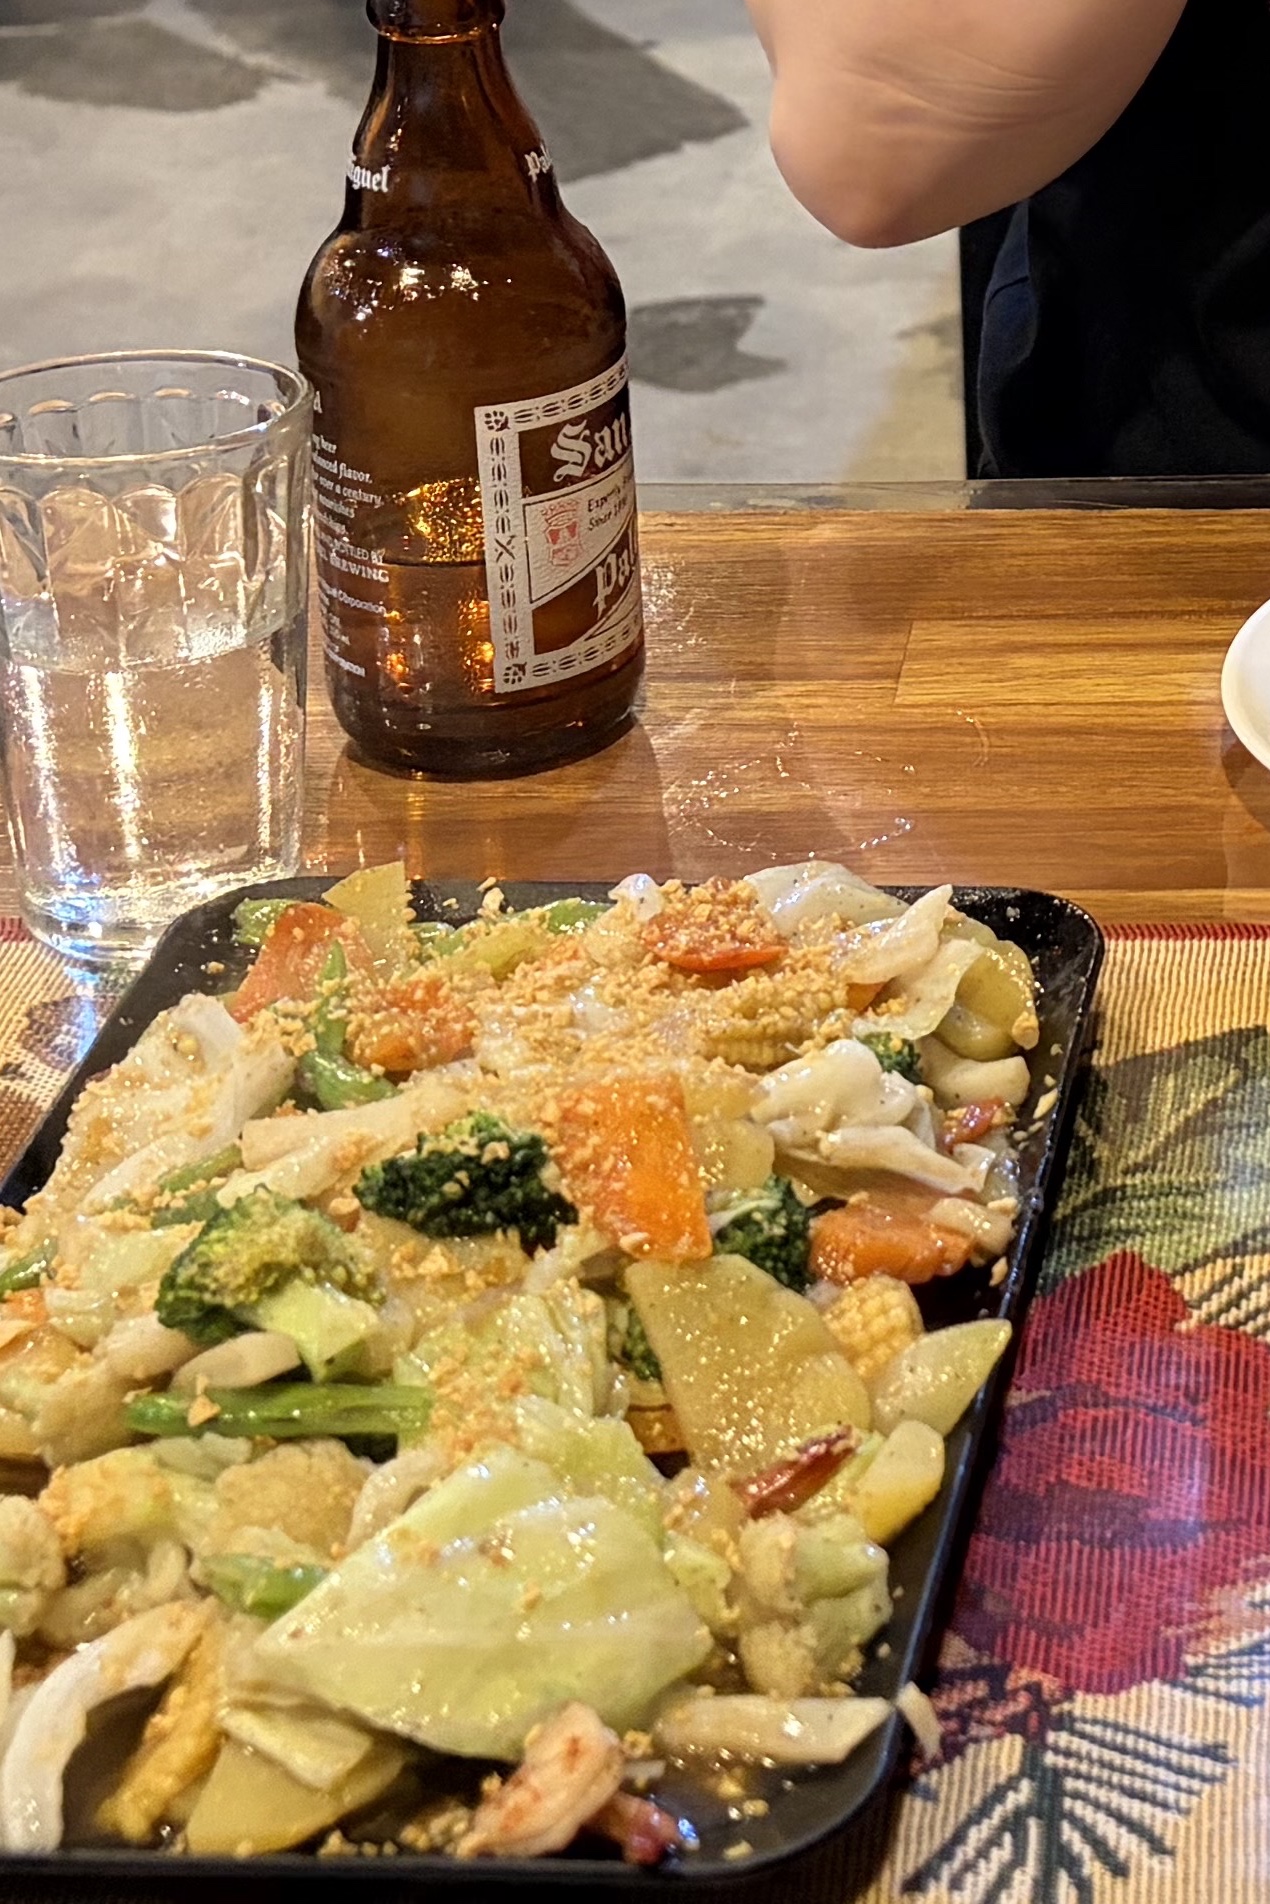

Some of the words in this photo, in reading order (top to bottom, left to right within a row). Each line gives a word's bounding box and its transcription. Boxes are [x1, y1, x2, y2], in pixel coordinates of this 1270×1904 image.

[339, 462, 373, 484] flavor.
[551, 412, 628, 482] San
[592, 518, 639, 621] Pal
